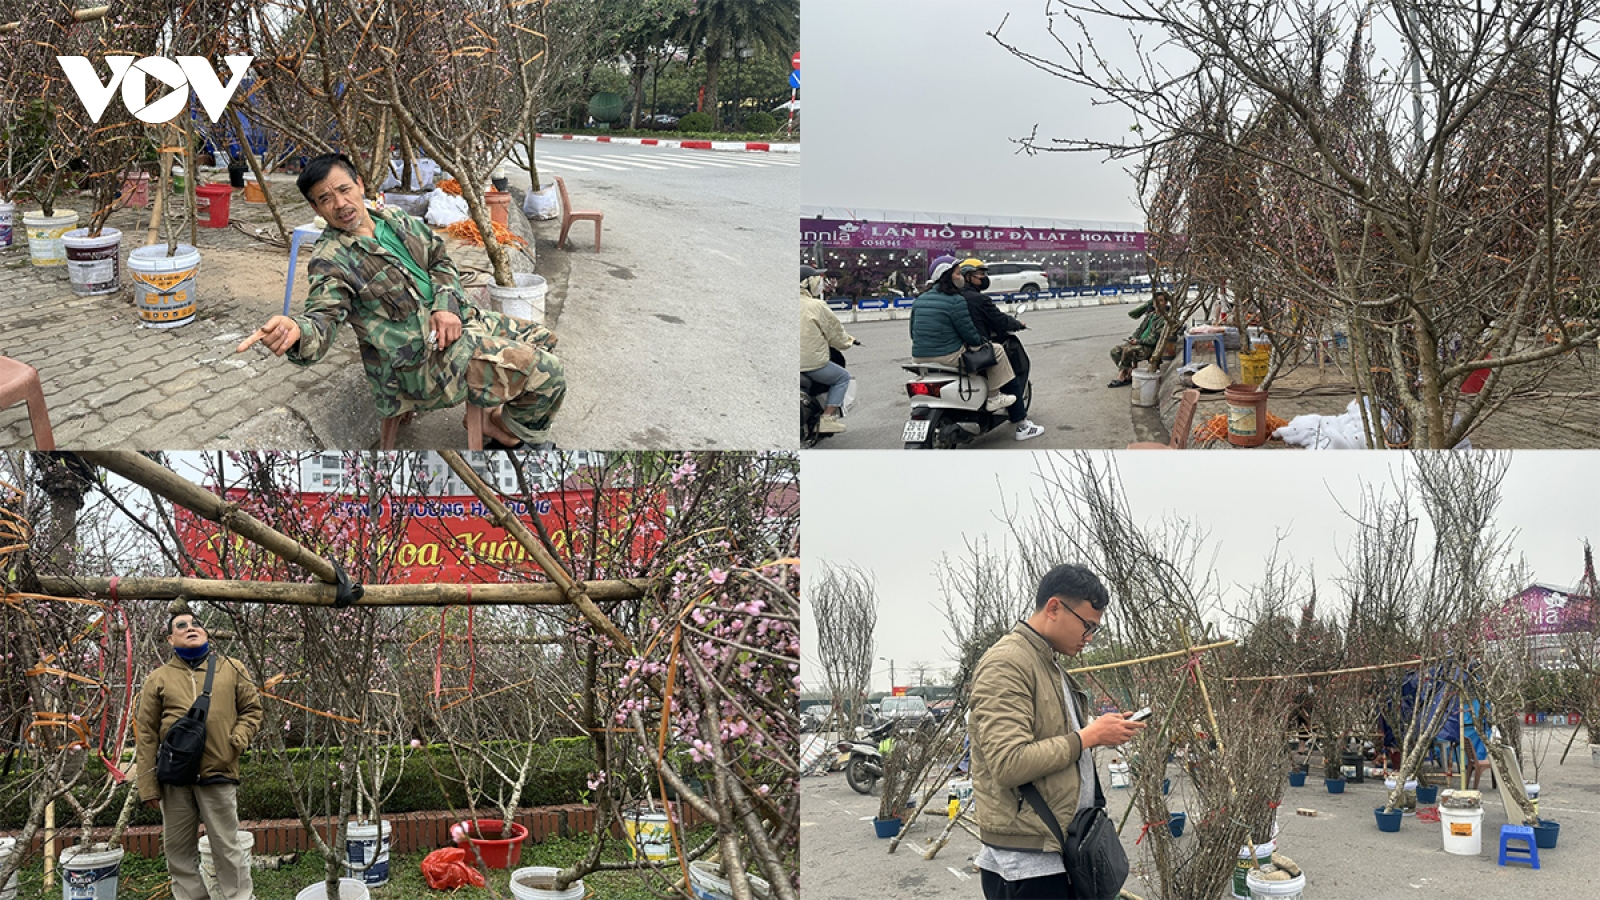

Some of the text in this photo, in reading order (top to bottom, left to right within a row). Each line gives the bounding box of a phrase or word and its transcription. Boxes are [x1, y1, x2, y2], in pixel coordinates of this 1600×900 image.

[871, 226, 917, 237] LAN
[960, 228, 1004, 241] ĐIỆP
[1040, 232, 1067, 242] LẠT
[1080, 233, 1112, 242] HOA
